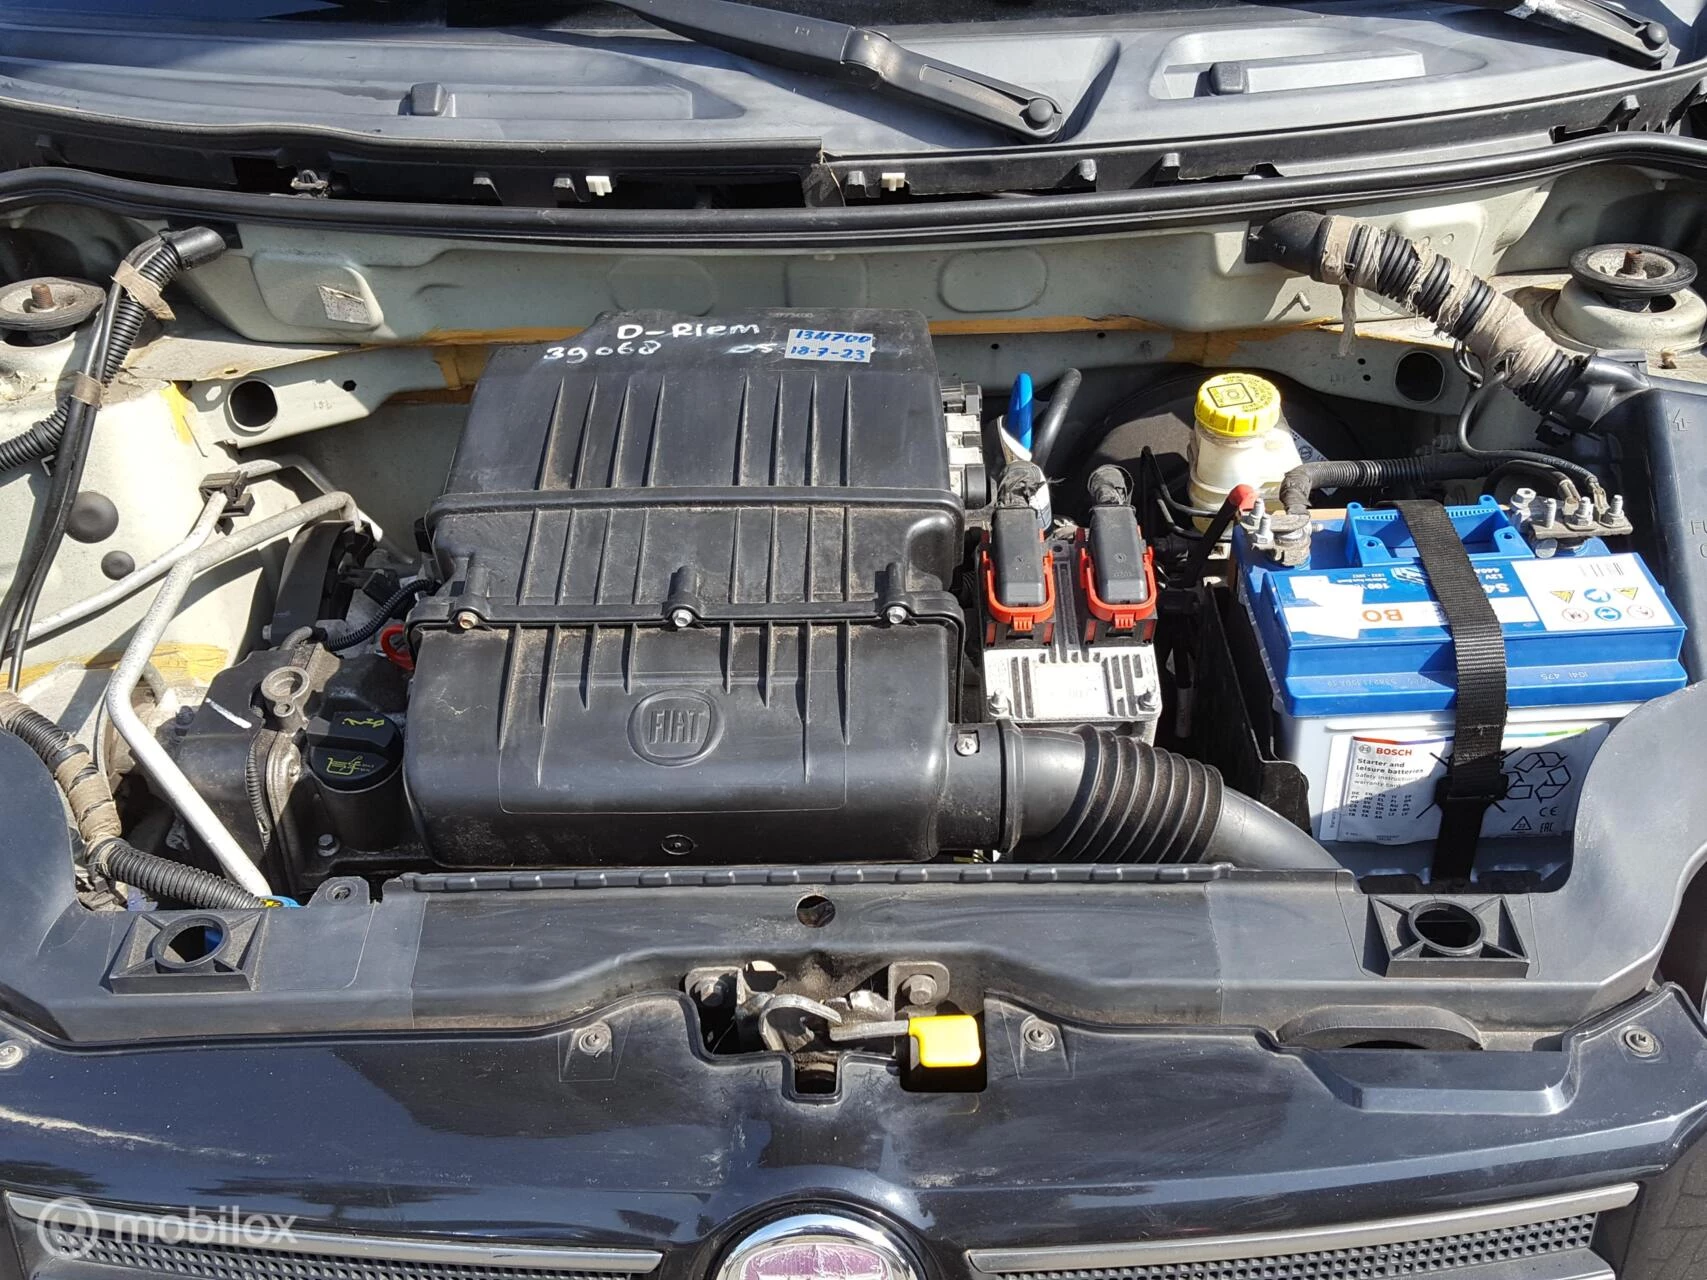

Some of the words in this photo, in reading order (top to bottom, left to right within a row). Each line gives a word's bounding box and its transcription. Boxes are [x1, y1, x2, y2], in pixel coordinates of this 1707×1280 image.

[796, 330, 872, 343] 134700
[790, 346, 865, 360] 18-7-23
[649, 708, 706, 744] FIAT
[1376, 747, 1412, 756] BOSCH
[1357, 758, 1388, 767] Starter
